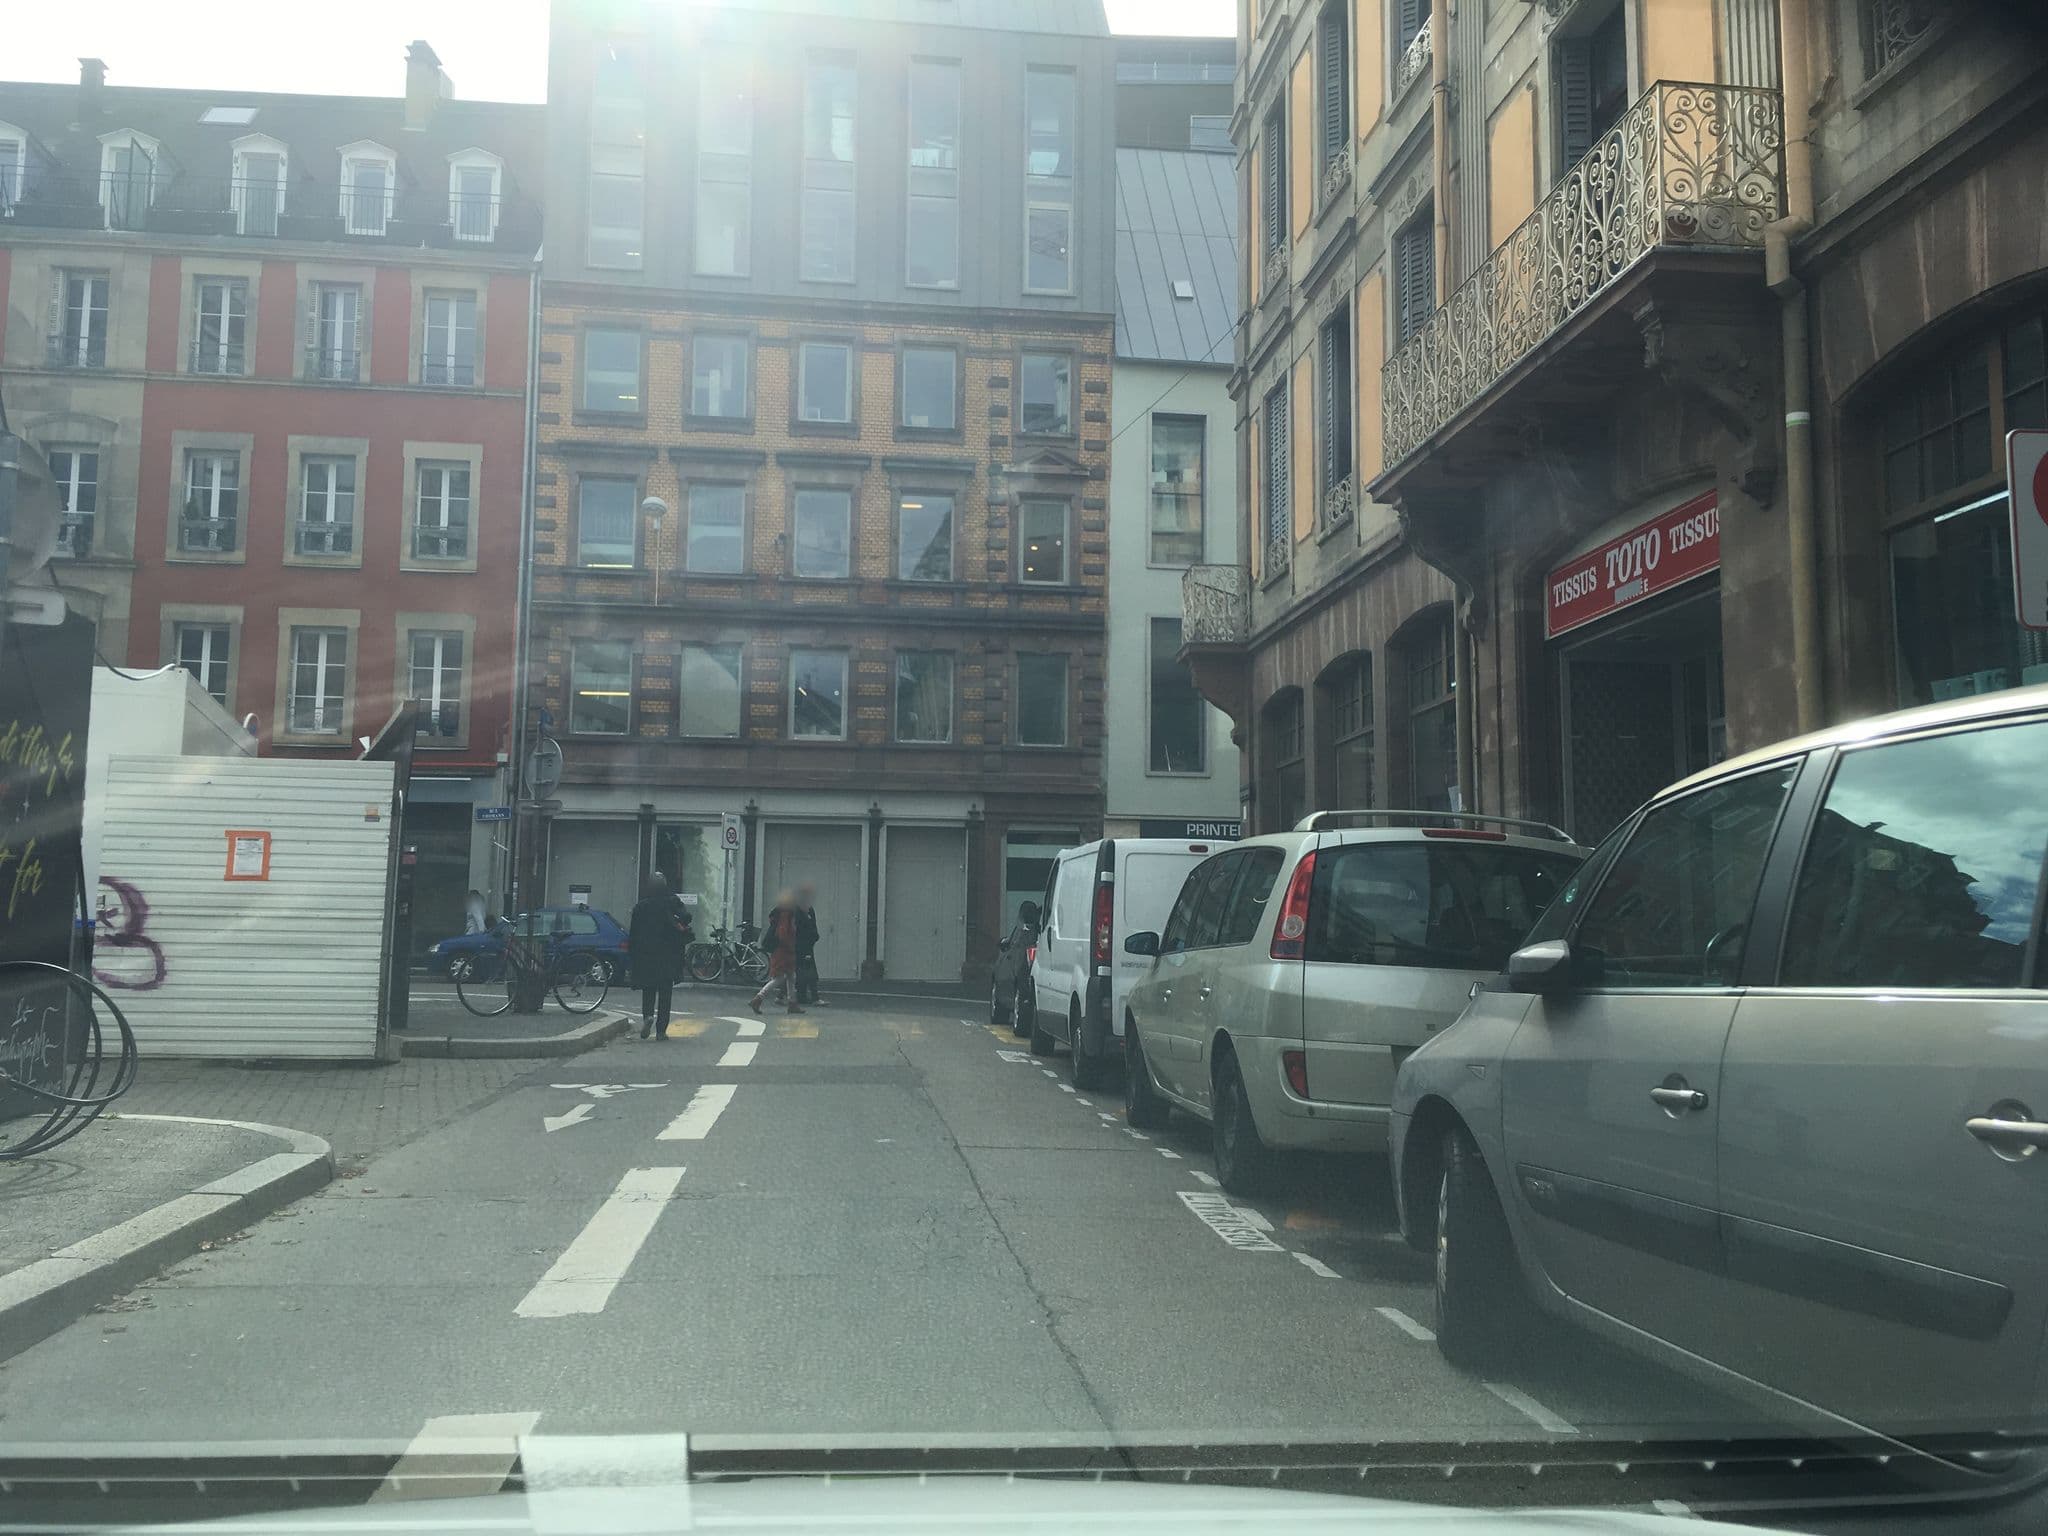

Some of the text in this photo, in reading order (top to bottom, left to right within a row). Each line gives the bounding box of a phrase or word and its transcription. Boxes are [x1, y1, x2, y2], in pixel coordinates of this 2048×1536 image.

[1553, 568, 1597, 608] TISSUS
[1606, 527, 1661, 590] TOTO
[1186, 823, 1241, 837] PRINTE
